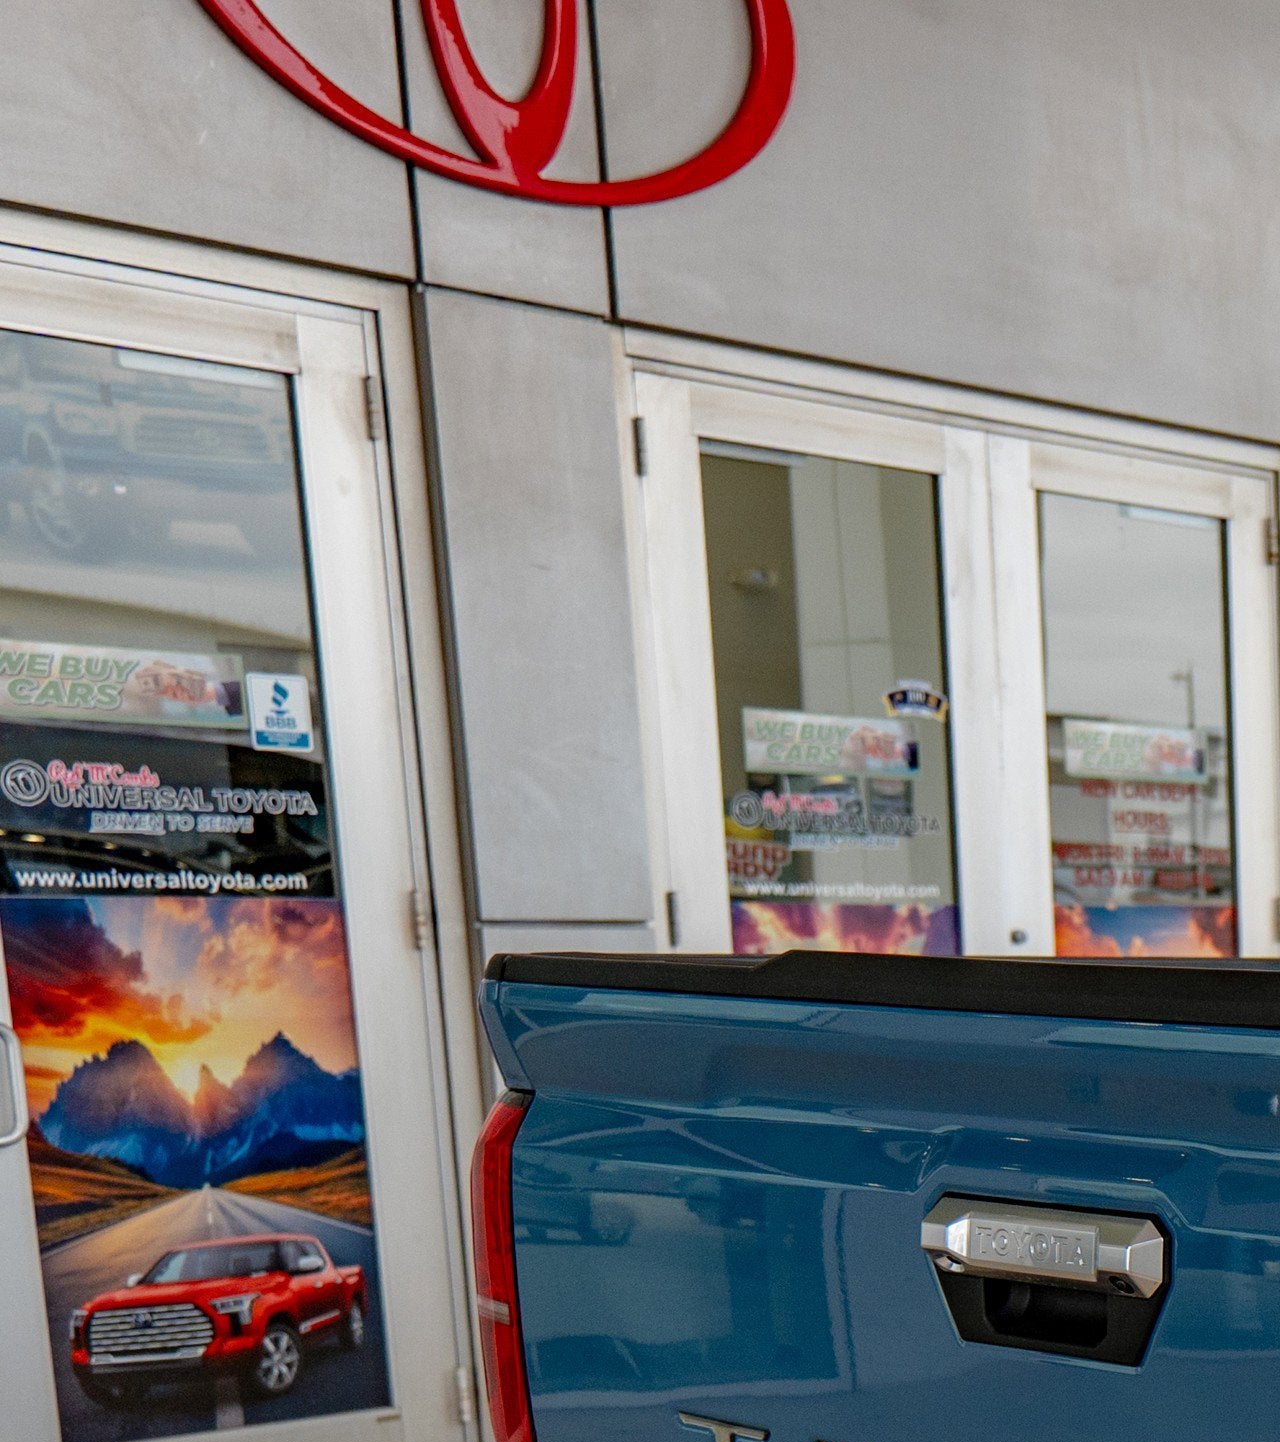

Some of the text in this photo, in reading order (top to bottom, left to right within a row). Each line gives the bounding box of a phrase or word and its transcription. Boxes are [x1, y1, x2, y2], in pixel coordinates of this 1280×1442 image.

[0, 650, 140, 684] WE BUY
[7, 678, 123, 711] CARS
[265, 716, 298, 730] BBB
[753, 719, 849, 742] WE BUY
[765, 742, 841, 765] CARS
[48, 760, 85, 789] Red
[50, 783, 319, 816] UNIVERSAL TOYOTA
[89, 810, 254, 835] DRIVEN TO SERVE
[15, 868, 309, 894] www.universaltoyota.com
[743, 879, 941, 898] www.universaltoyota.com
[976, 1225, 1088, 1267] TOYOTA
